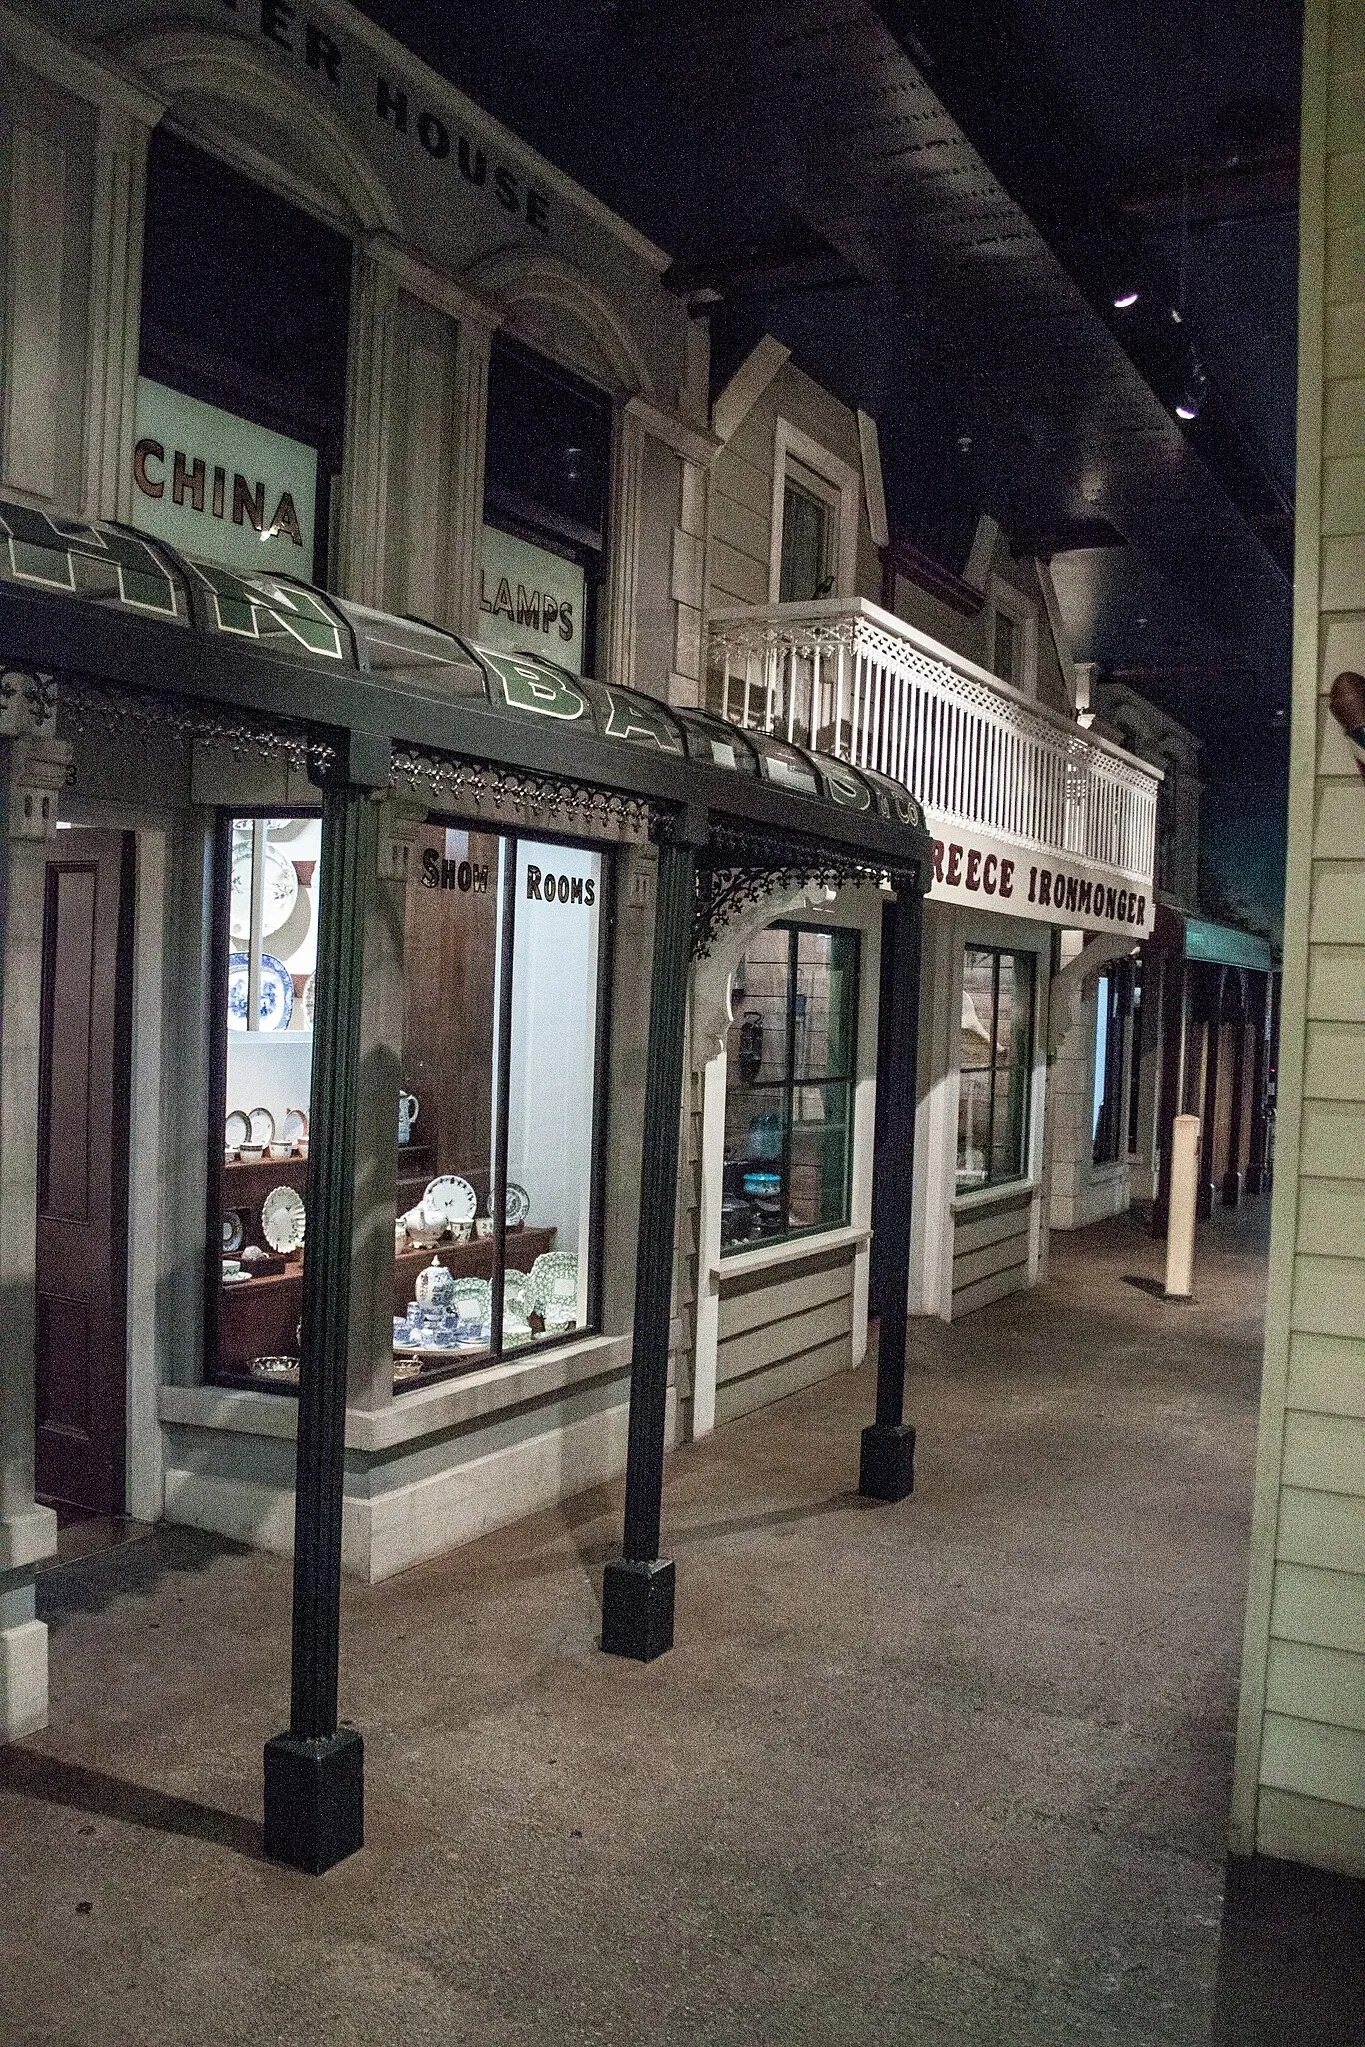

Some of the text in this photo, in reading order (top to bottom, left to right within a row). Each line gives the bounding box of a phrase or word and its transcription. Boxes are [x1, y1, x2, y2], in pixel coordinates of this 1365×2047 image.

[376, 77, 550, 234] HOUSE
[133, 439, 303, 547] CHINA
[479, 568, 574, 642] LAMPS
[66, 765, 77, 786] 3
[421, 847, 596, 907] SHOW ROOMS
[931, 840, 1145, 926] REECE IRONMONGER
